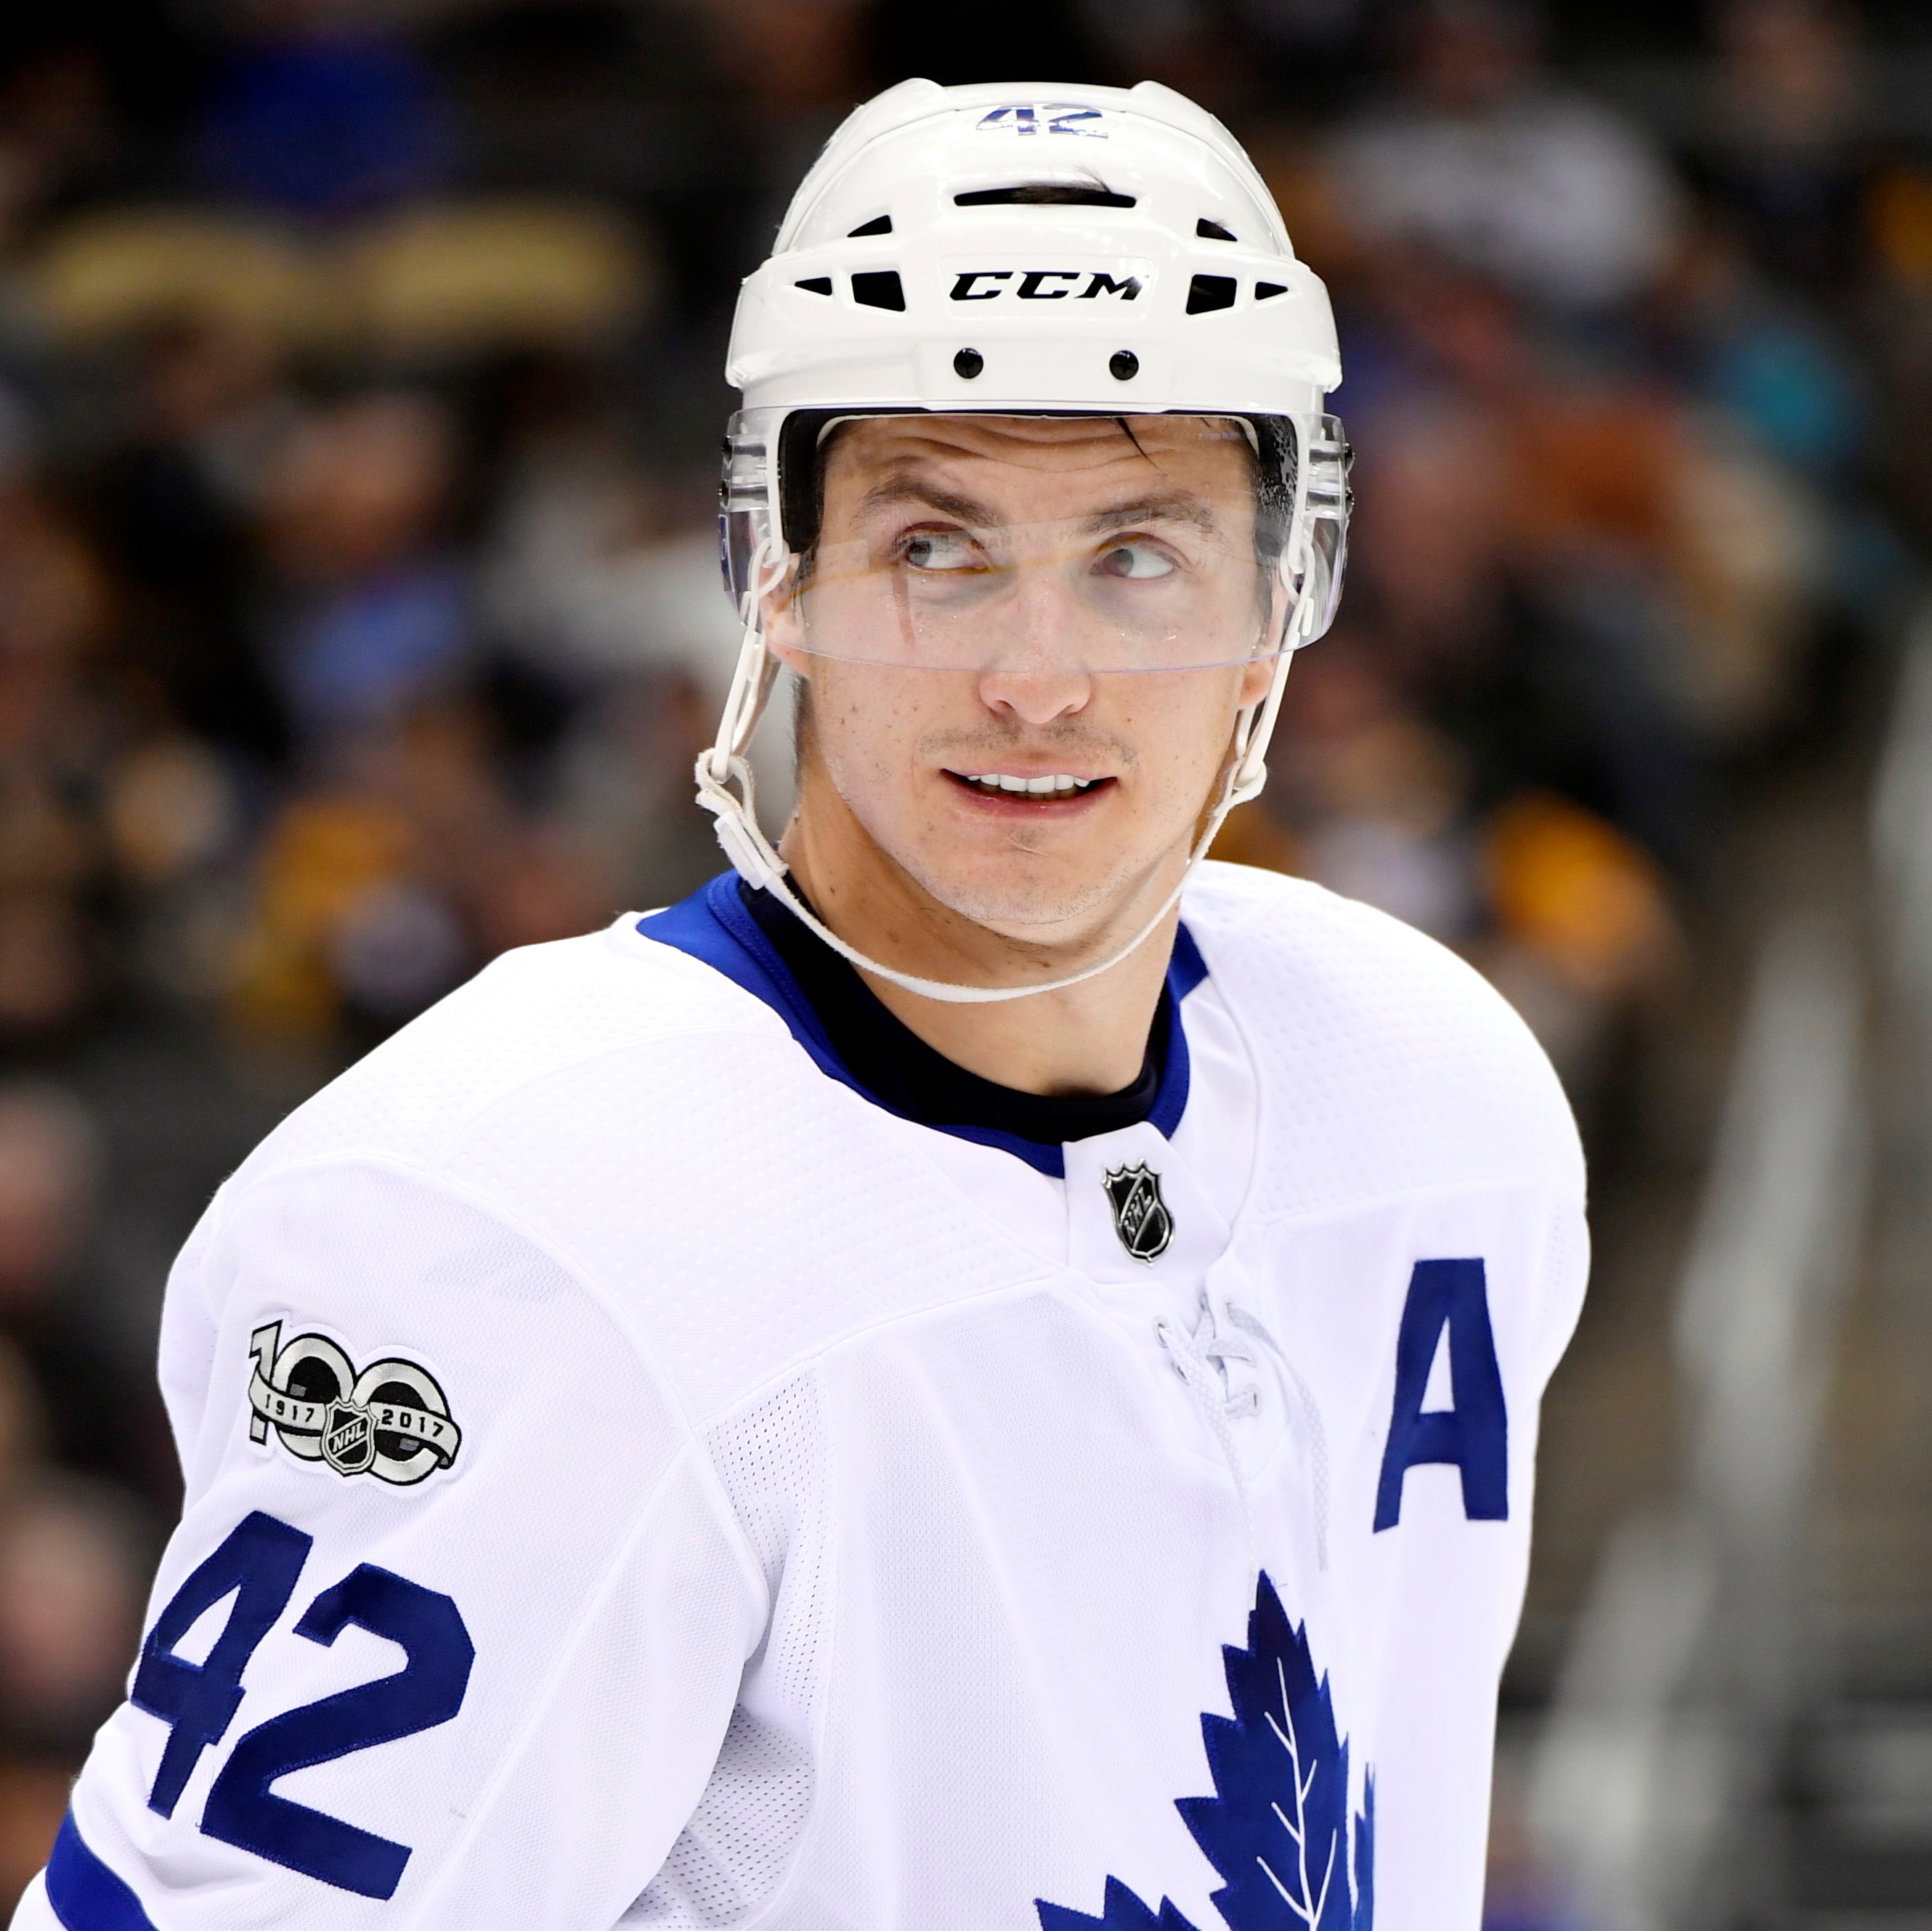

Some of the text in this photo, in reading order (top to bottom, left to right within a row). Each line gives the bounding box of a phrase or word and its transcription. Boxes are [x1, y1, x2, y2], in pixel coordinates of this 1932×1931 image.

[976, 103, 1109, 139] 42
[949, 271, 1143, 301] CCM
[248, 1319, 452, 1487] 100
[265, 1394, 445, 1437] 1917 2017
[1373, 1258, 1509, 1534] A
[333, 1422, 365, 1453] NHL
[131, 1510, 476, 1900] 42
